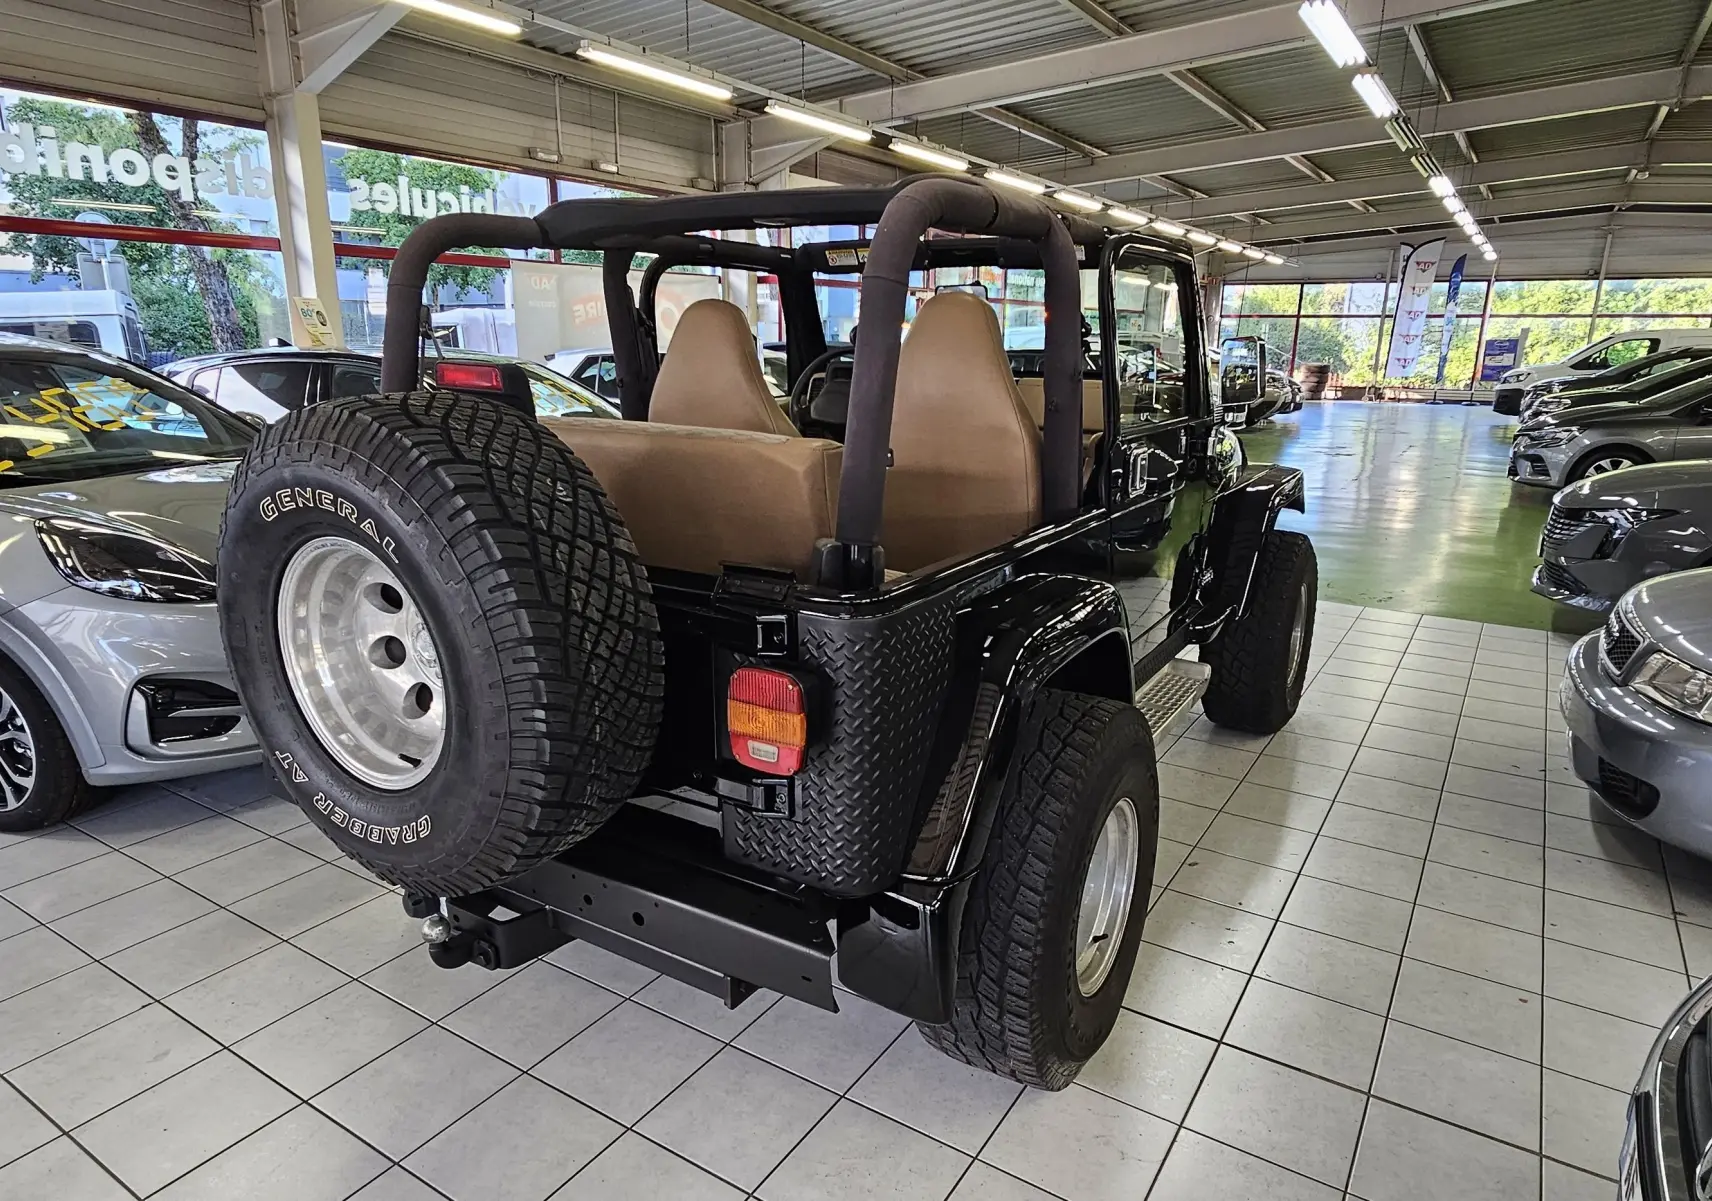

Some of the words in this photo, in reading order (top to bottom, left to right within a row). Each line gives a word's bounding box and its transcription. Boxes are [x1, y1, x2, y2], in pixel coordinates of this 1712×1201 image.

[259, 487, 400, 564] GENERAL
[275, 748, 309, 784] AT
[313, 791, 431, 845] GRABBER
